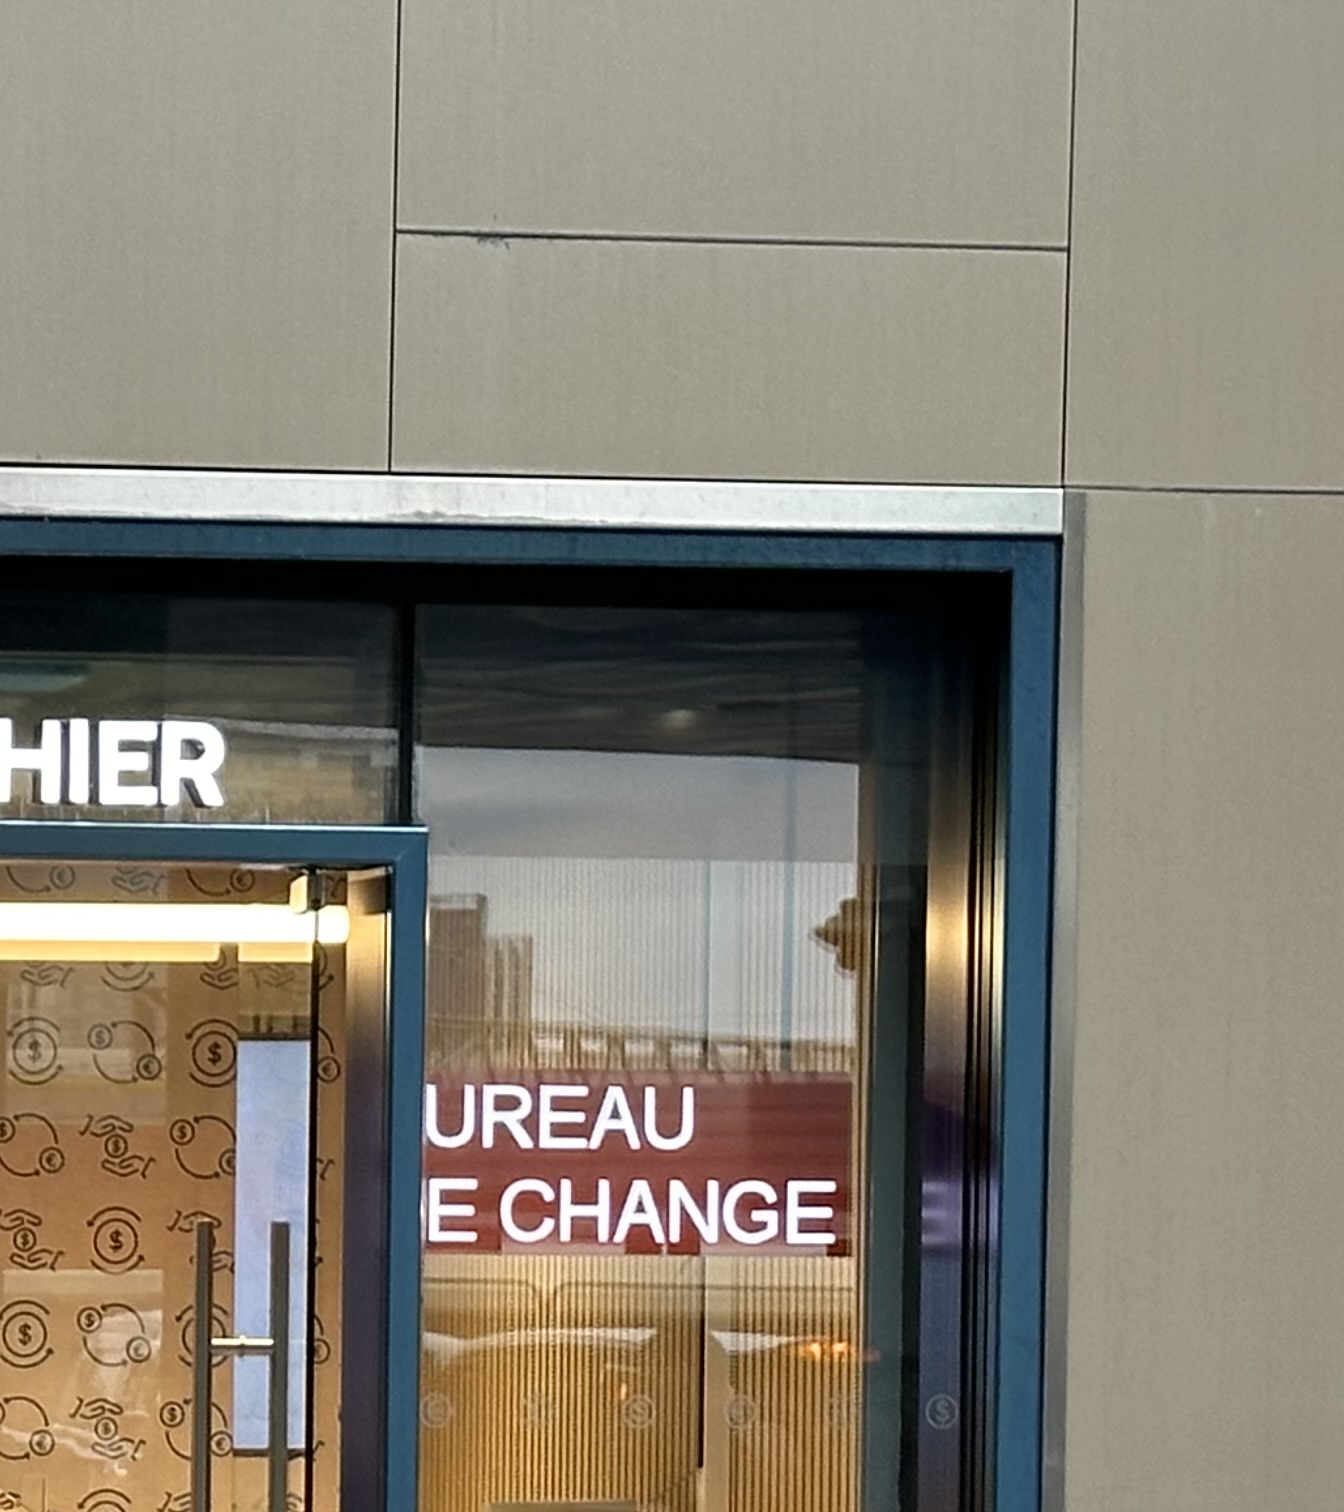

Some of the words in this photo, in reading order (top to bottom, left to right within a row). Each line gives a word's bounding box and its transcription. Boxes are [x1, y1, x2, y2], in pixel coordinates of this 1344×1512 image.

[425, 1083, 696, 1150] UREAU
[420, 1178, 479, 1243] E
[500, 1178, 837, 1245] CHANGE
